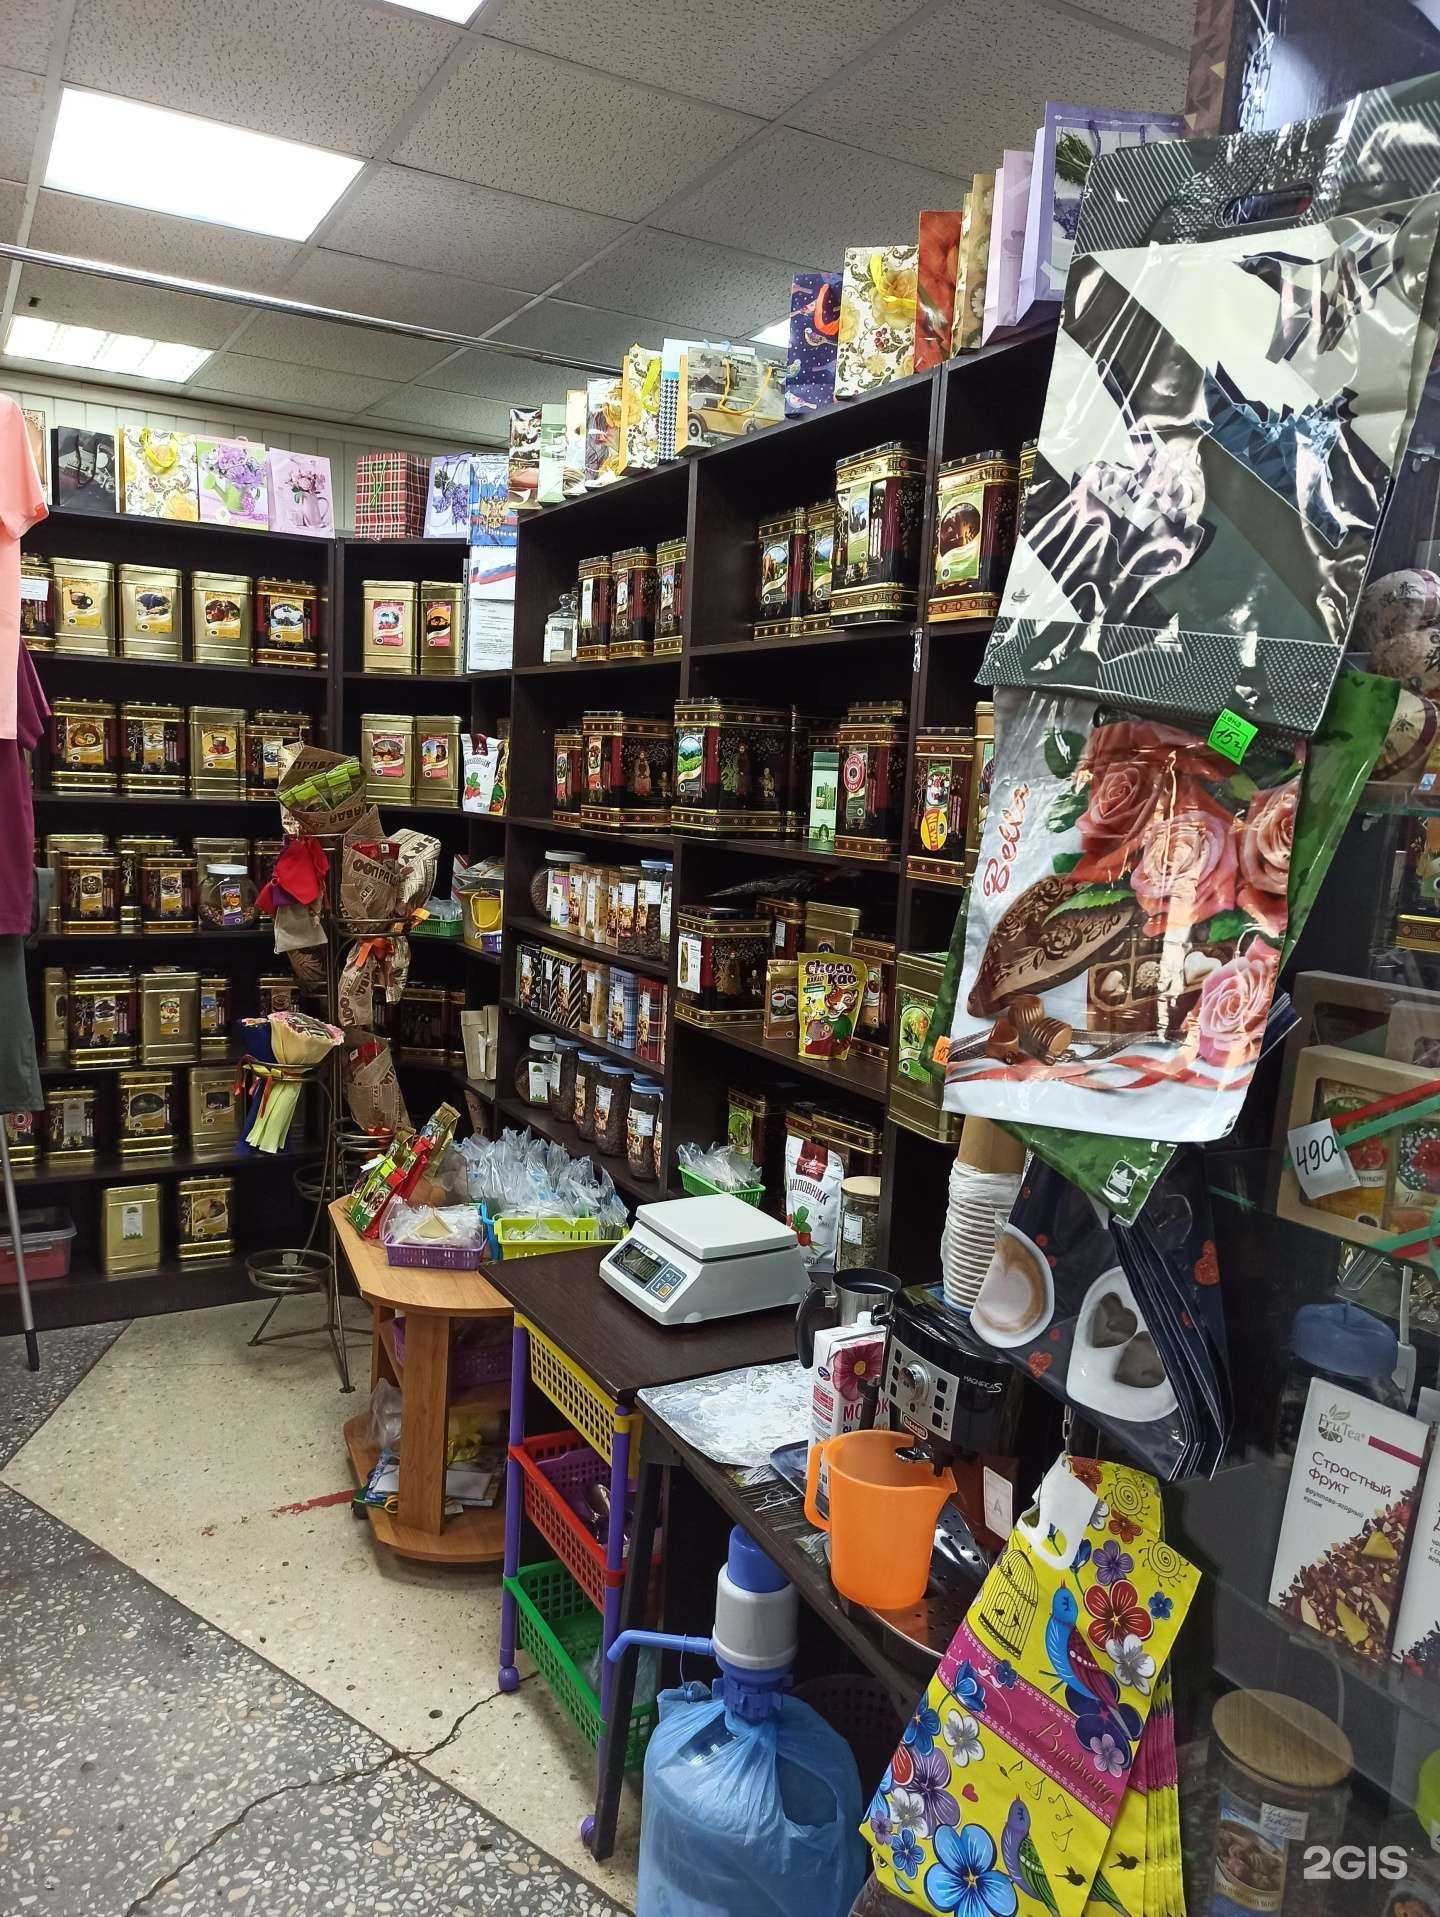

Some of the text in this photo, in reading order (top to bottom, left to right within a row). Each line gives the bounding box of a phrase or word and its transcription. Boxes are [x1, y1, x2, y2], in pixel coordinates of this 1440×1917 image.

[983, 782, 1030, 897] Bella
[805, 960, 853, 975] Choco
[1312, 1451, 1392, 1498] Страстный
[1036, 1721, 1117, 1804] Birdsong
